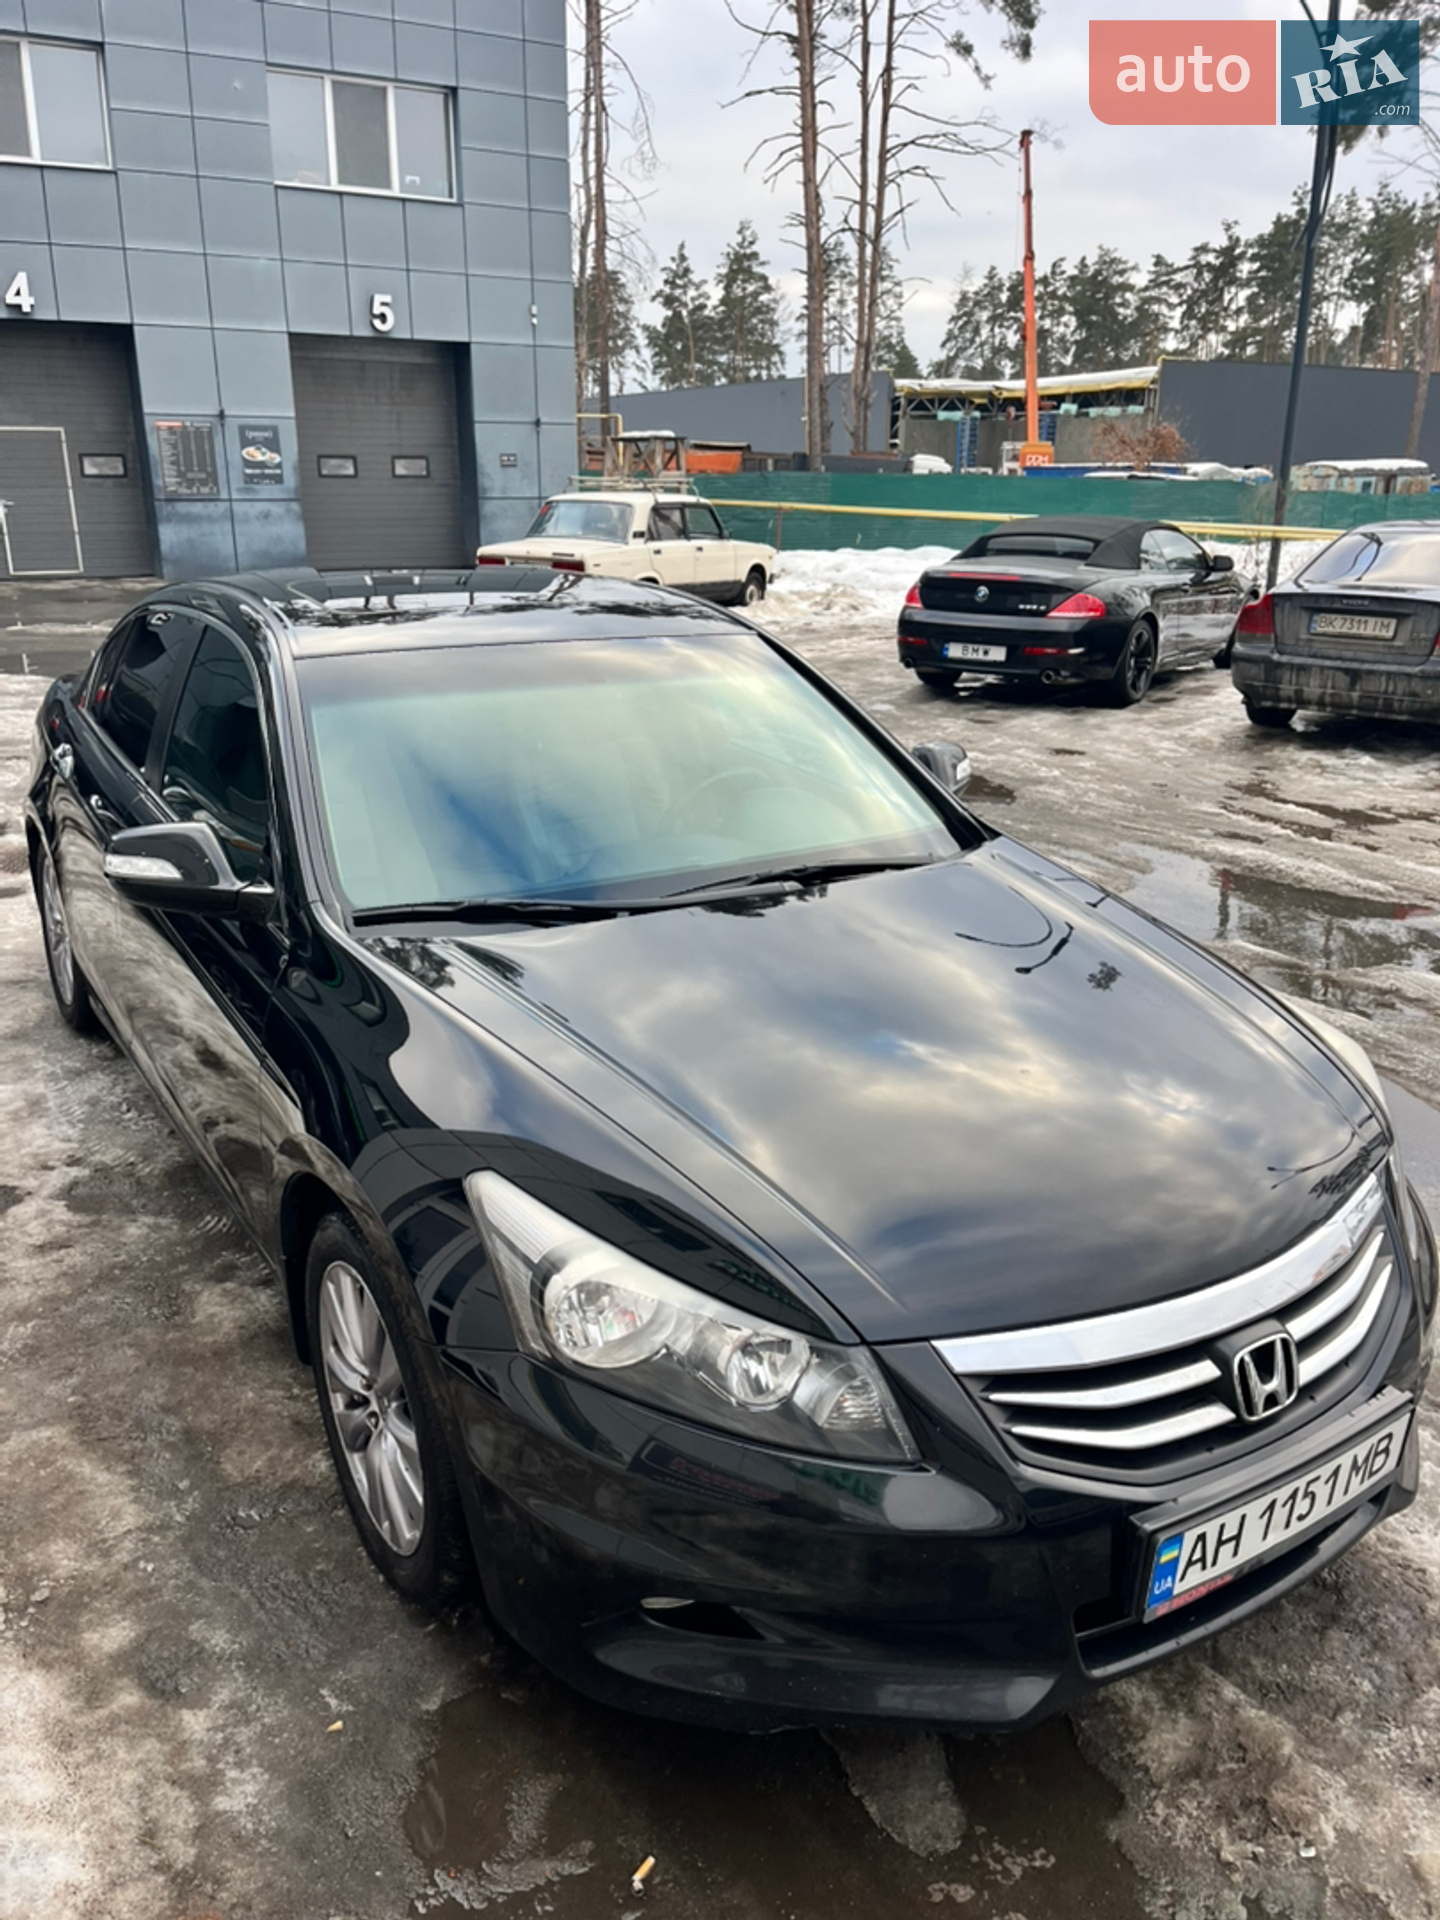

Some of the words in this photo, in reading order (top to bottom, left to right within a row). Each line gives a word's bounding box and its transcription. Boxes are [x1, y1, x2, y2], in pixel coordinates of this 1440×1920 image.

[5, 271, 35, 313] 4
[370, 293, 395, 333] 5
[1318, 615, 1338, 629] BK
[1339, 618, 1368, 632] 7311
[1373, 621, 1391, 634] IM
[961, 645, 991, 656] BMW
[1179, 1513, 1247, 1583] AH
[1259, 1464, 1343, 1542] 1151
[1343, 1431, 1395, 1496] MB
[1153, 1575, 1173, 1595] UA
